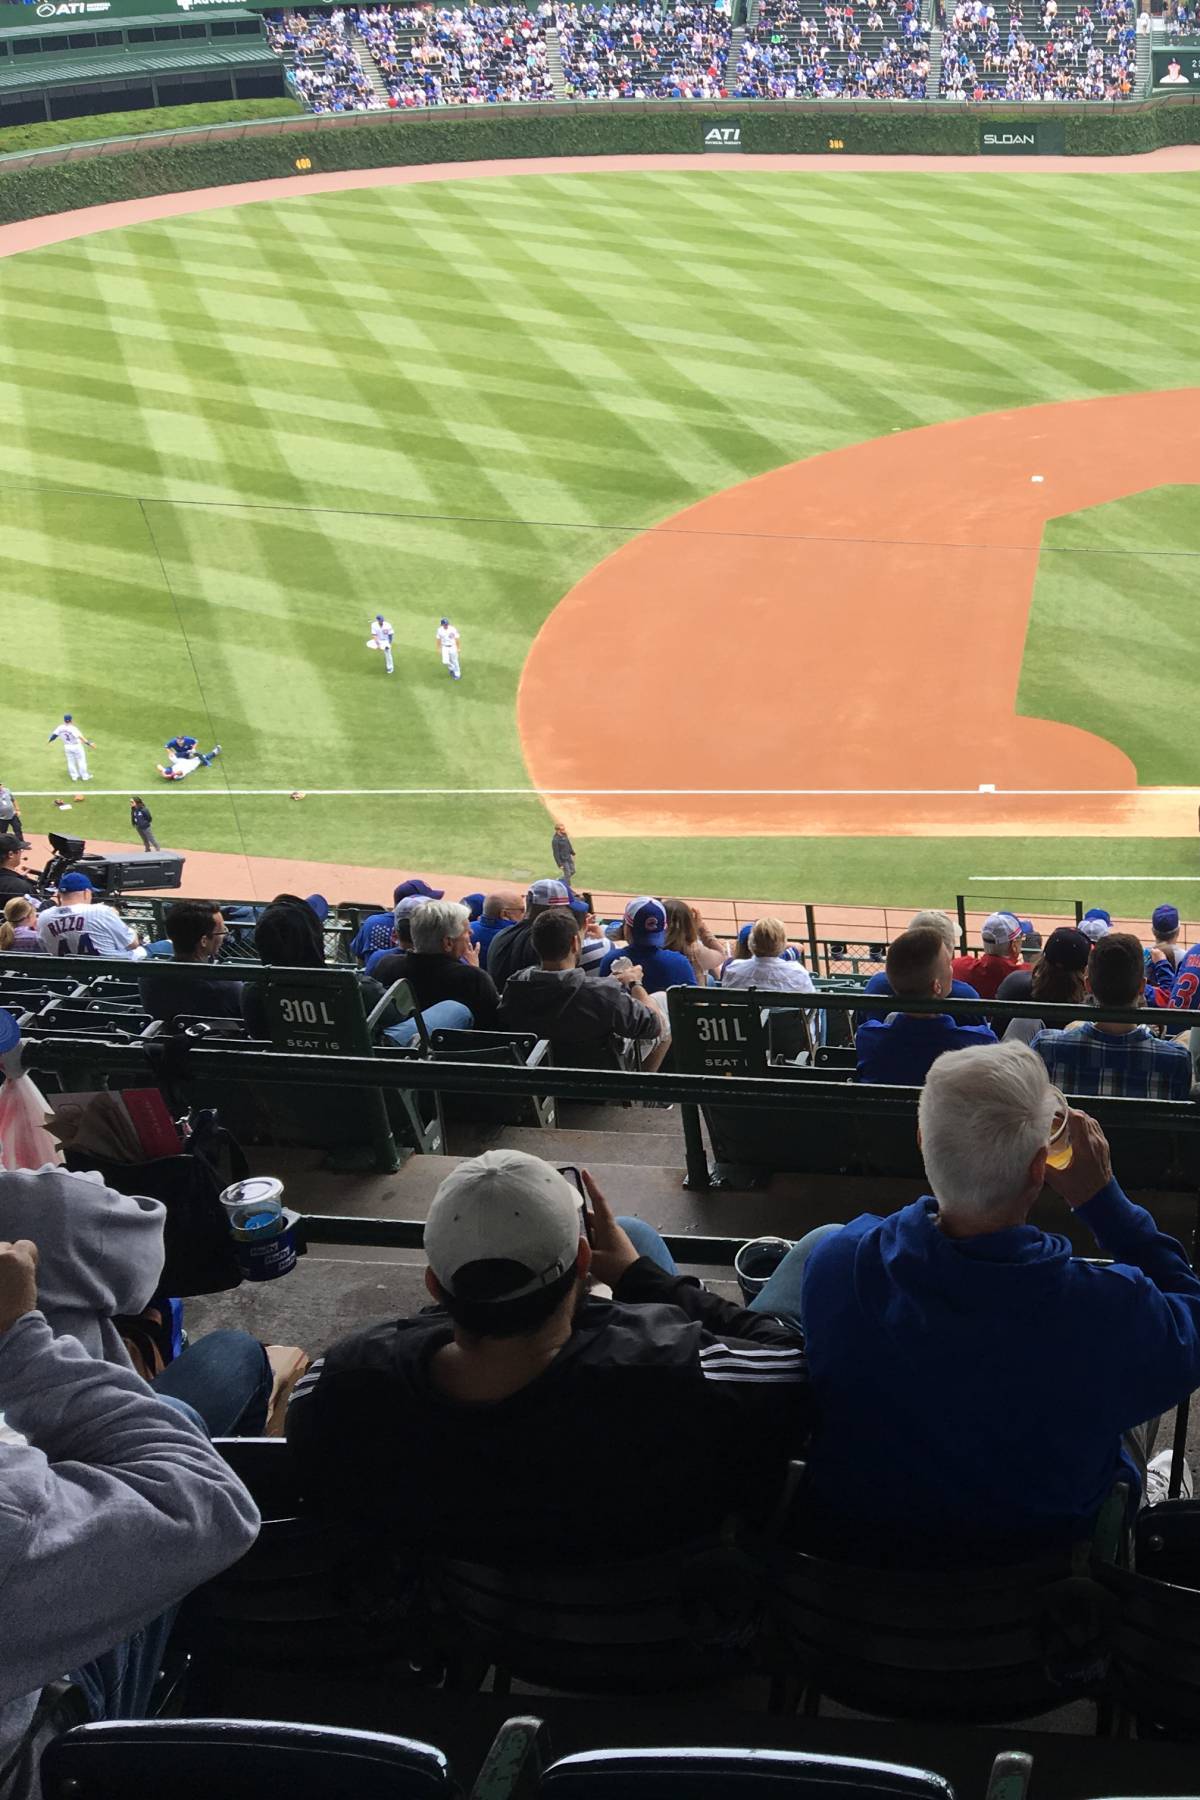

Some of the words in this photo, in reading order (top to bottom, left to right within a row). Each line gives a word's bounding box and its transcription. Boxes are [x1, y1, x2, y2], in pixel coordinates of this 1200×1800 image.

[56, 2, 84, 15] ATI
[704, 128, 741, 140] ATI
[983, 134, 1035, 145] SLOAN
[47, 916, 85, 937] RIZZO
[280, 998, 318, 1024] 310
[320, 1001, 335, 1025] L
[696, 1017, 729, 1041] 311
[733, 1018, 748, 1041] L
[287, 1039, 320, 1048] SEAT
[325, 1042, 340, 1050] 16
[705, 1059, 739, 1067] SEAT
